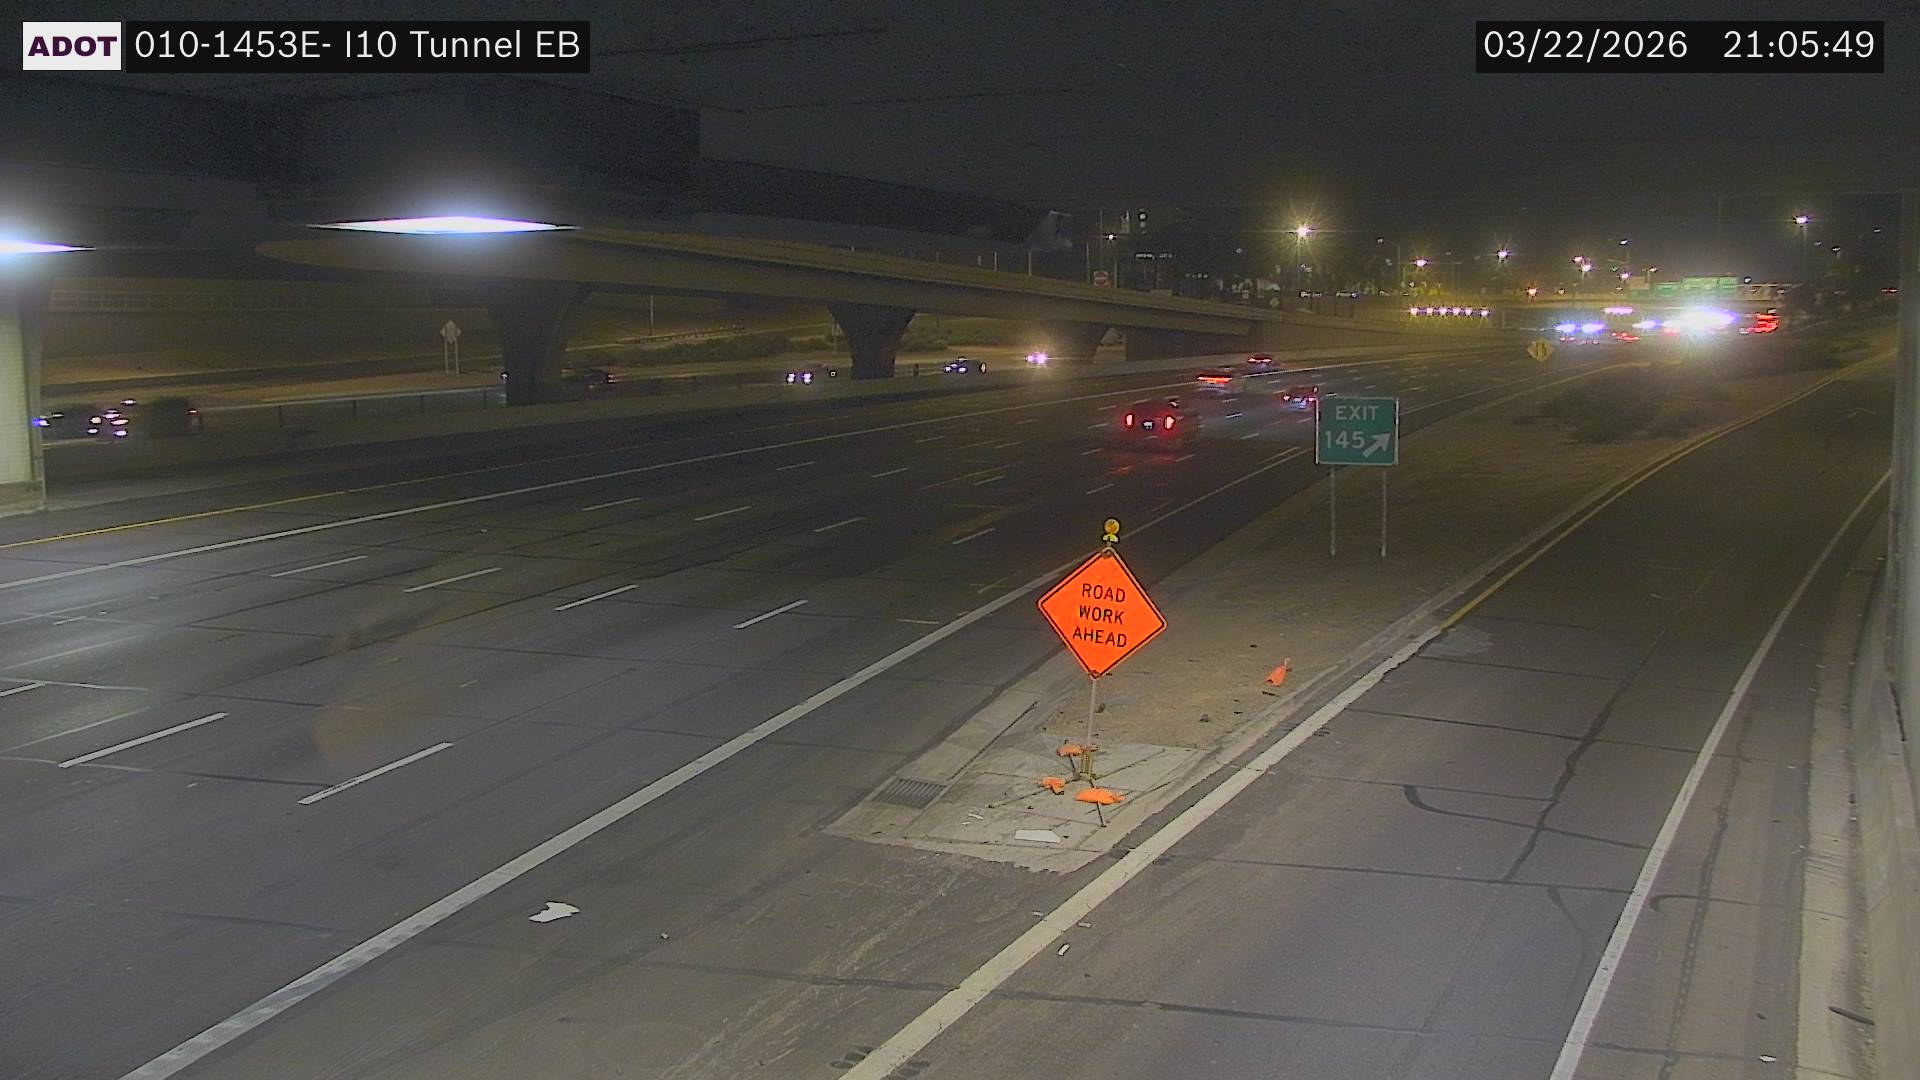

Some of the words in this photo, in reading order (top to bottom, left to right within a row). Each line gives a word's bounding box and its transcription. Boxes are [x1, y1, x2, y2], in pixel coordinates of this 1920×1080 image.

[1335, 405, 1379, 421] EXIT
[1325, 430, 1365, 449] 145
[1081, 583, 1126, 603] ROAD
[1079, 605, 1125, 625] WORK
[1072, 626, 1127, 648] AHEAD
